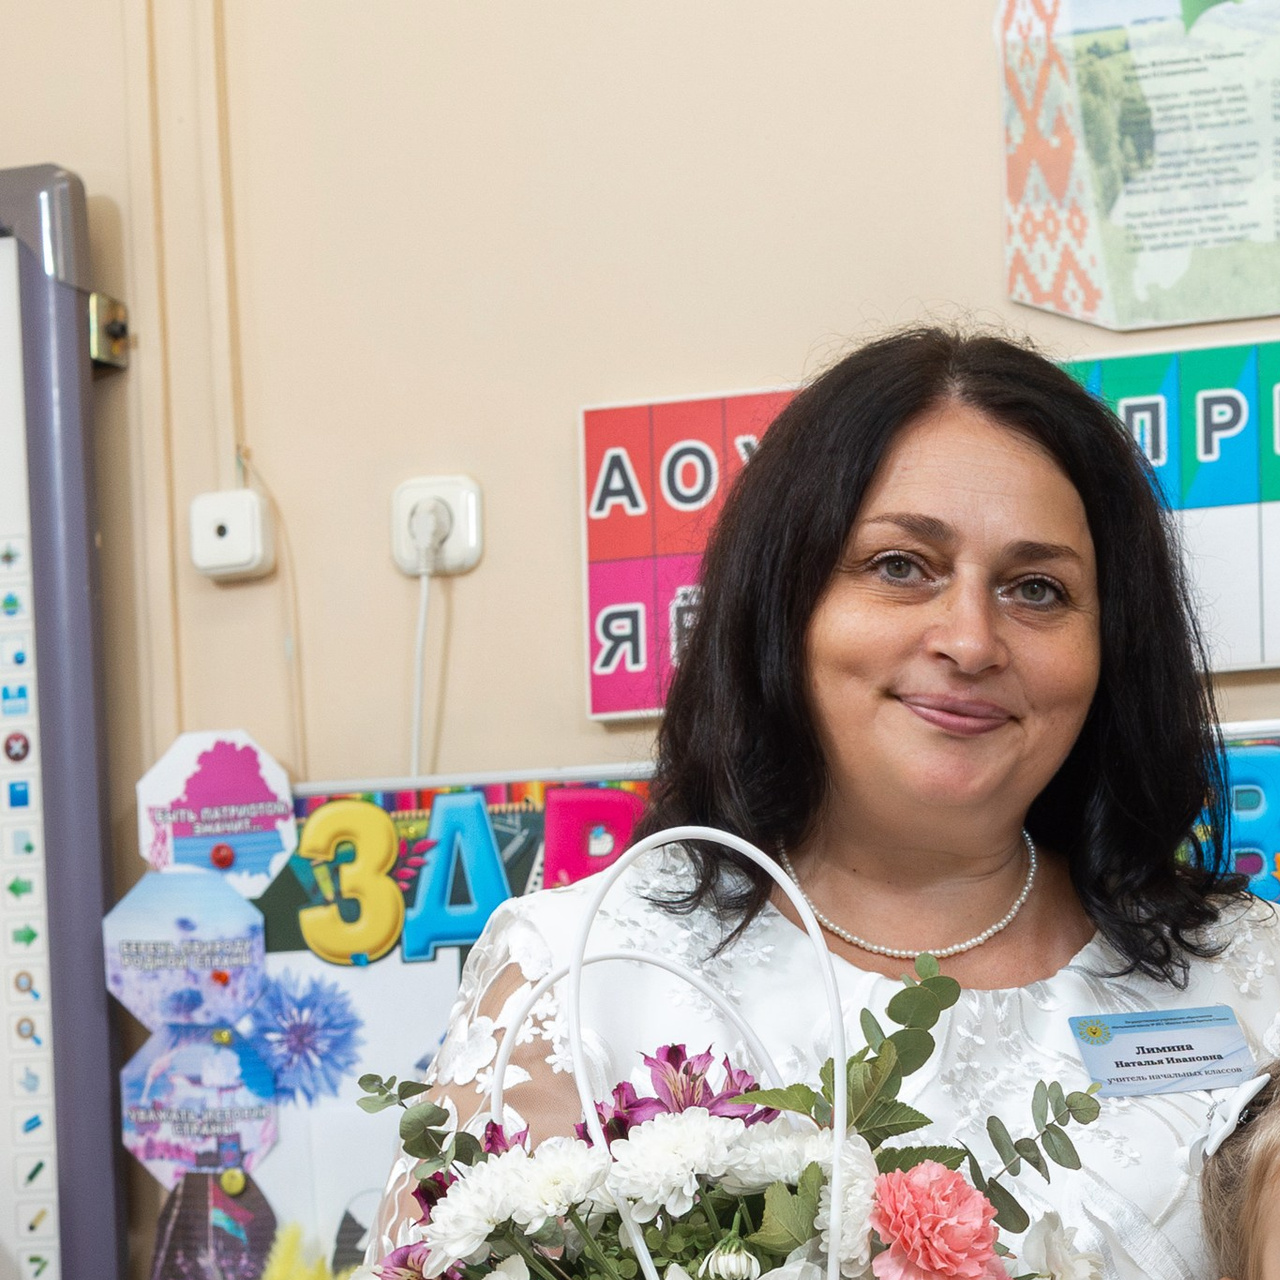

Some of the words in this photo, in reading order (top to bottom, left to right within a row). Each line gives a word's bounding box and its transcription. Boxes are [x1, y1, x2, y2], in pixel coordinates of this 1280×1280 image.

[593, 452, 644, 514] А
[665, 445, 714, 506] О
[1201, 393, 1244, 457] Р
[598, 608, 644, 672] Я
[1136, 1042, 1194, 1056] Лимина
[1114, 1057, 1164, 1069] Наталья
[1165, 1052, 1224, 1065] Ивановна
[1107, 1073, 1147, 1085] учитель
[1149, 1069, 1202, 1082] начальных
[1204, 1066, 1243, 1076] классов
